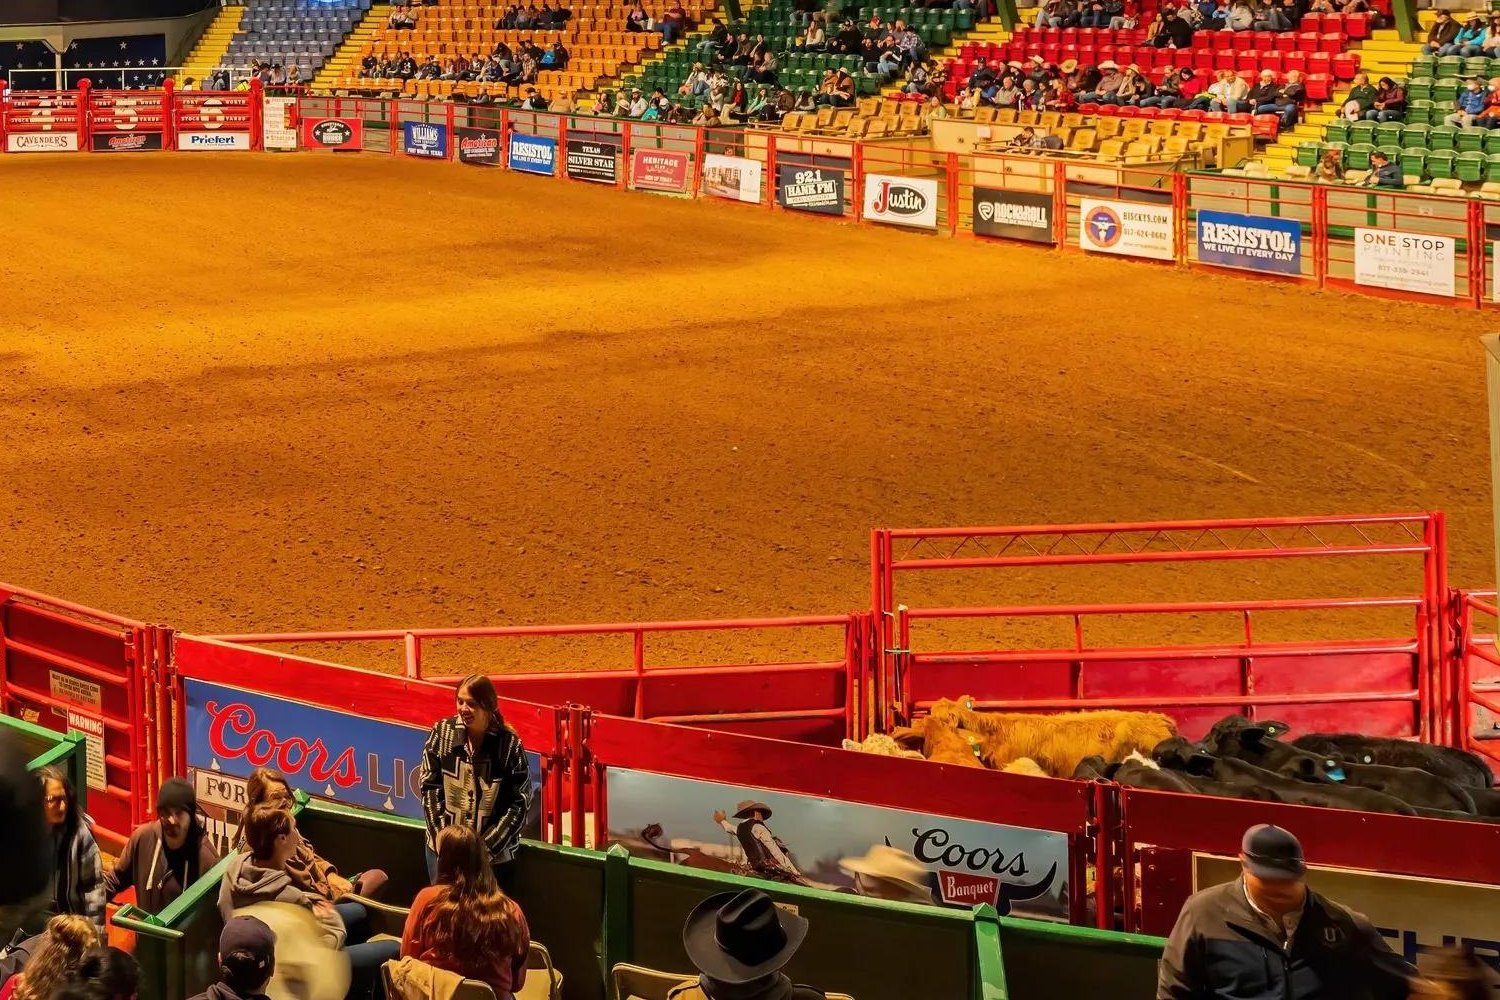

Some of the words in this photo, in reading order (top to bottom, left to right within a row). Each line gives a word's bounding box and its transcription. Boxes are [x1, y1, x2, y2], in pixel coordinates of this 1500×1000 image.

[16, 135, 68, 148] CAVENDER'S
[191, 134, 235, 144] Priefert
[411, 126, 438, 142] WILLIAMS
[461, 137, 498, 150] American
[513, 141, 552, 160] RESISTOL
[568, 156, 593, 166] SILVER
[594, 159, 614, 168] STAR
[643, 157, 679, 167] HERITAGE
[795, 169, 822, 184] 92.1
[788, 184, 817, 197] HANK
[816, 182, 834, 194] FM
[874, 182, 923, 213] Justin
[994, 202, 1047, 222] ROCK&ROLL
[1202, 222, 1296, 253] RESISTOL
[1363, 233, 1396, 246] ONE
[1402, 237, 1445, 251] STOP
[1204, 242, 1217, 251] WE
[1218, 244, 1235, 253] LIVE
[1246, 249, 1273, 258] EVERY
[1275, 252, 1294, 261] DAY
[1364, 244, 1445, 261] PRINTING
[69, 712, 102, 735] WARNING
[206, 701, 363, 788] Coors
[206, 776, 247, 804] FOR
[911, 828, 1030, 877] Coors
[947, 876, 994, 900] Banquet
